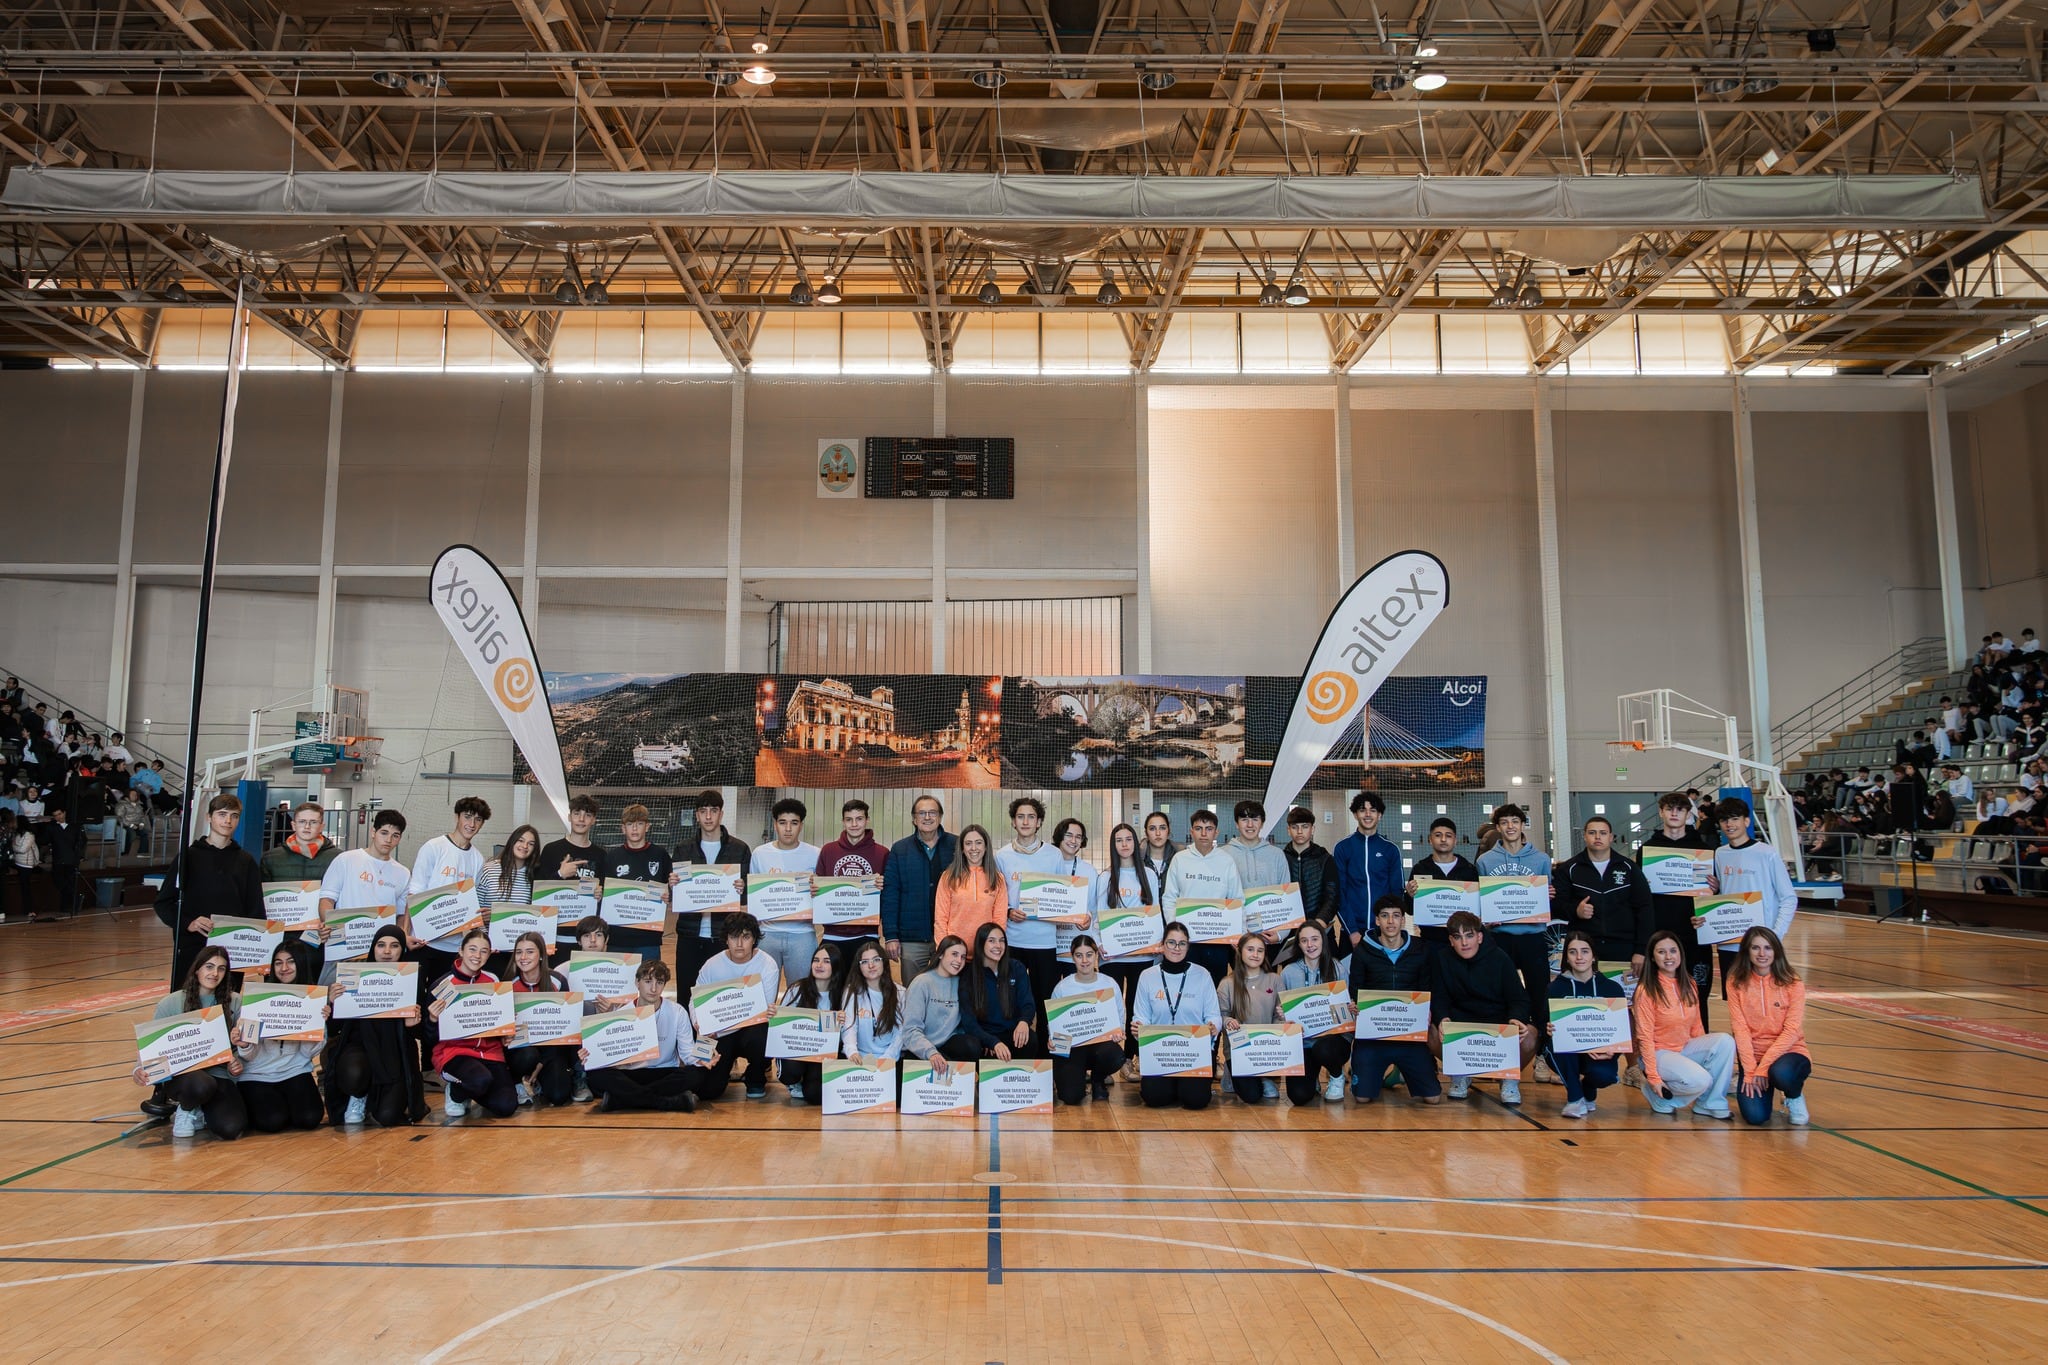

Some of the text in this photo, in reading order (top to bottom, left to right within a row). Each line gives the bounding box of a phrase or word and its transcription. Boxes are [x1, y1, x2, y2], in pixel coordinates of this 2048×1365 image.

[1340, 573, 1438, 674] aitex
[1442, 681, 1482, 694] Alcoi
[592, 966, 620, 974] OLIMPÍADAS
[363, 977, 394, 986] OLIMPÍADAS
[463, 997, 491, 1007] OLIMPÍADAS
[716, 990, 744, 1003] OLIMPÍADAS
[270, 999, 302, 1007] OLIMPÍADAS
[1303, 997, 1330, 1009] OLIMPÍADAS
[1069, 1005, 1096, 1017] OLIMPÍADAS
[1576, 1013, 1605, 1021] OLIMPÍADAS
[167, 1026, 201, 1042] OLIMPÍADAS
[606, 1023, 634, 1035] OLIMPÍADAS
[158, 1038, 215, 1056] GANADOR TARJETA REGALO
[1467, 1038, 1496, 1046] OLIMPÍADAS
[170, 1056, 192, 1066] VALORADA
[846, 1074, 874, 1082] OLIMPÍADAS
